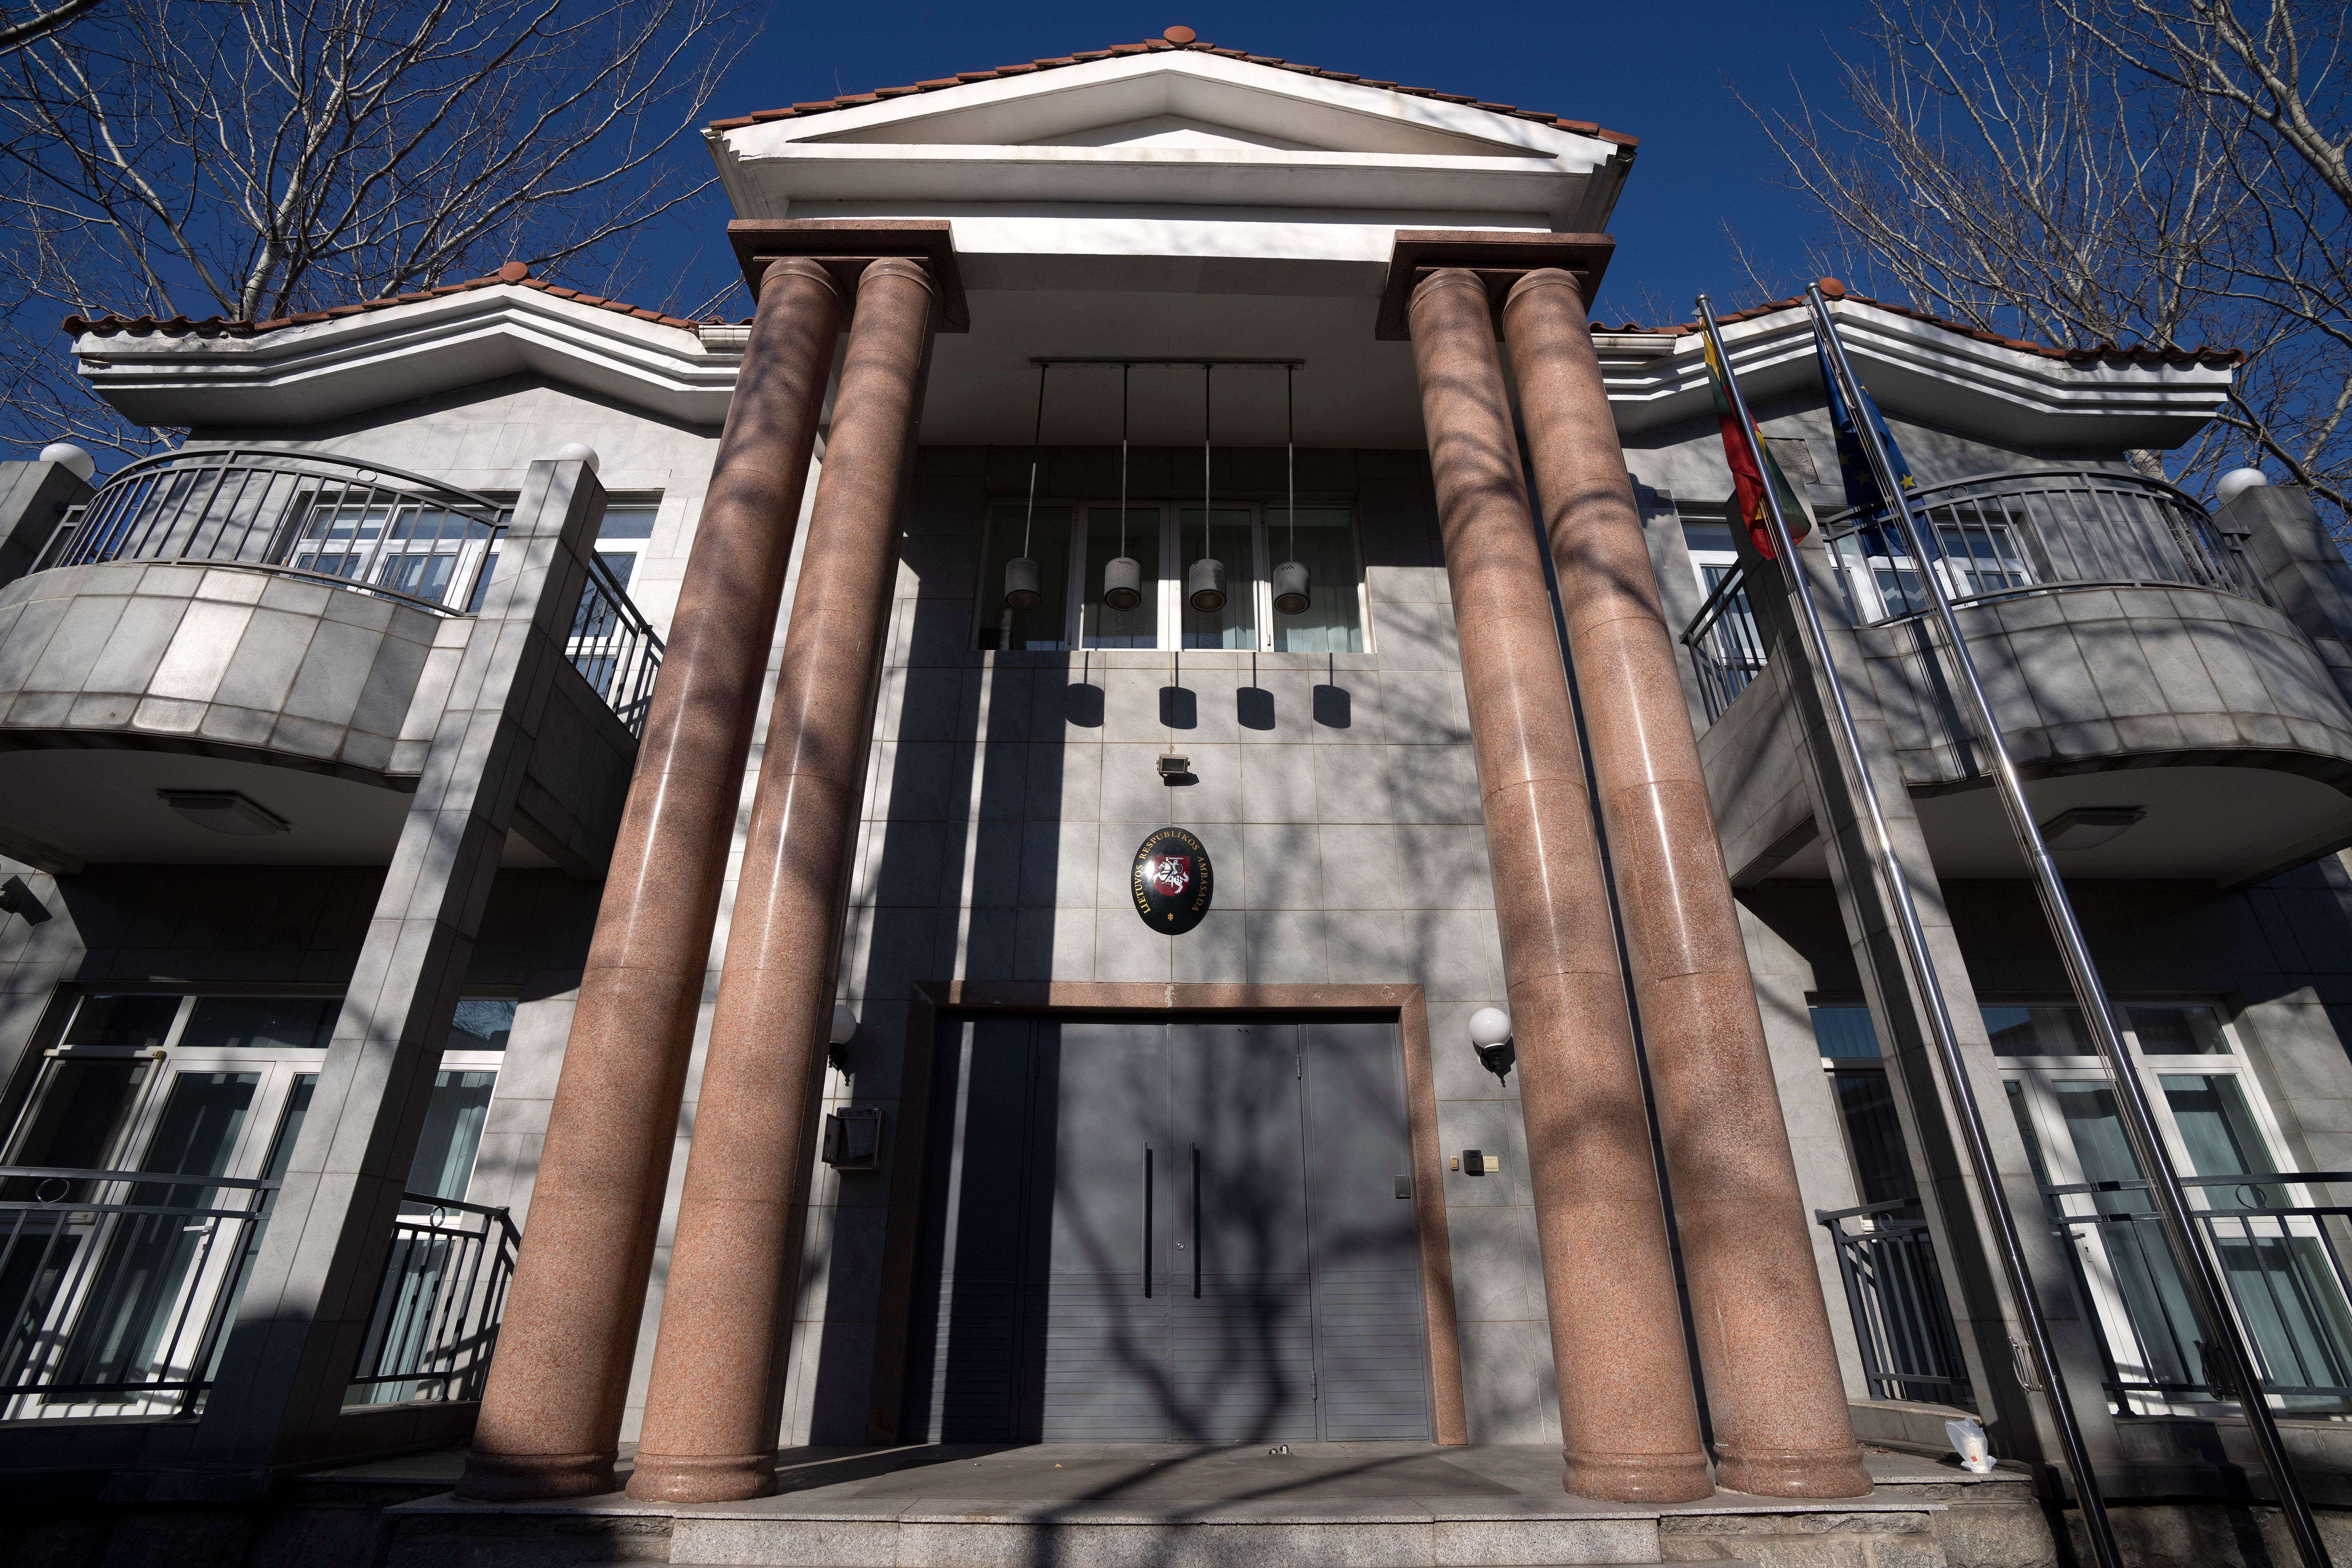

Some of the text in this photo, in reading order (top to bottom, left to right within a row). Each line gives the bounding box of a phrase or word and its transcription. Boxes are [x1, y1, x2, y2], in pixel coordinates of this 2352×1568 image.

[1134, 831, 1208, 914] LIETUVOS RESPUBLIKOS AMBASADA
